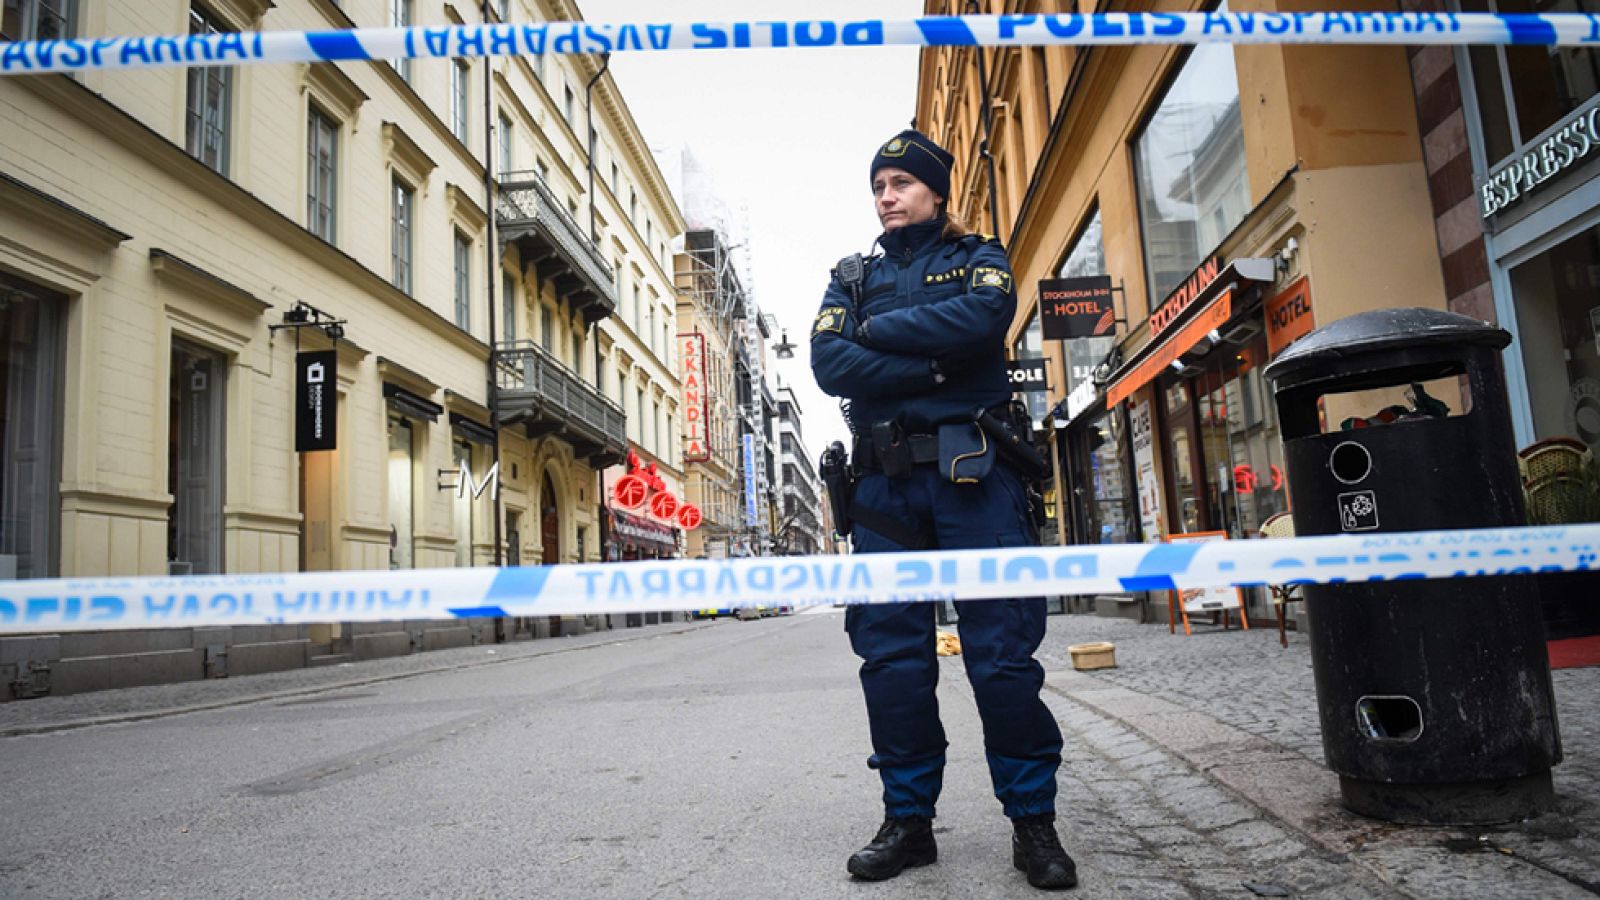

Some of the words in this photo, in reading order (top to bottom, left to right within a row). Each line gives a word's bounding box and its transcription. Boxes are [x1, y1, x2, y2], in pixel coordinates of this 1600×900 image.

[690, 20, 884, 49] POLIS
[1043, 290, 1092, 300] STOCKHOLM
[1054, 301, 1101, 316] HOTEL
[1271, 294, 1311, 334] HOTEL
[685, 340, 702, 456] SKANDIA
